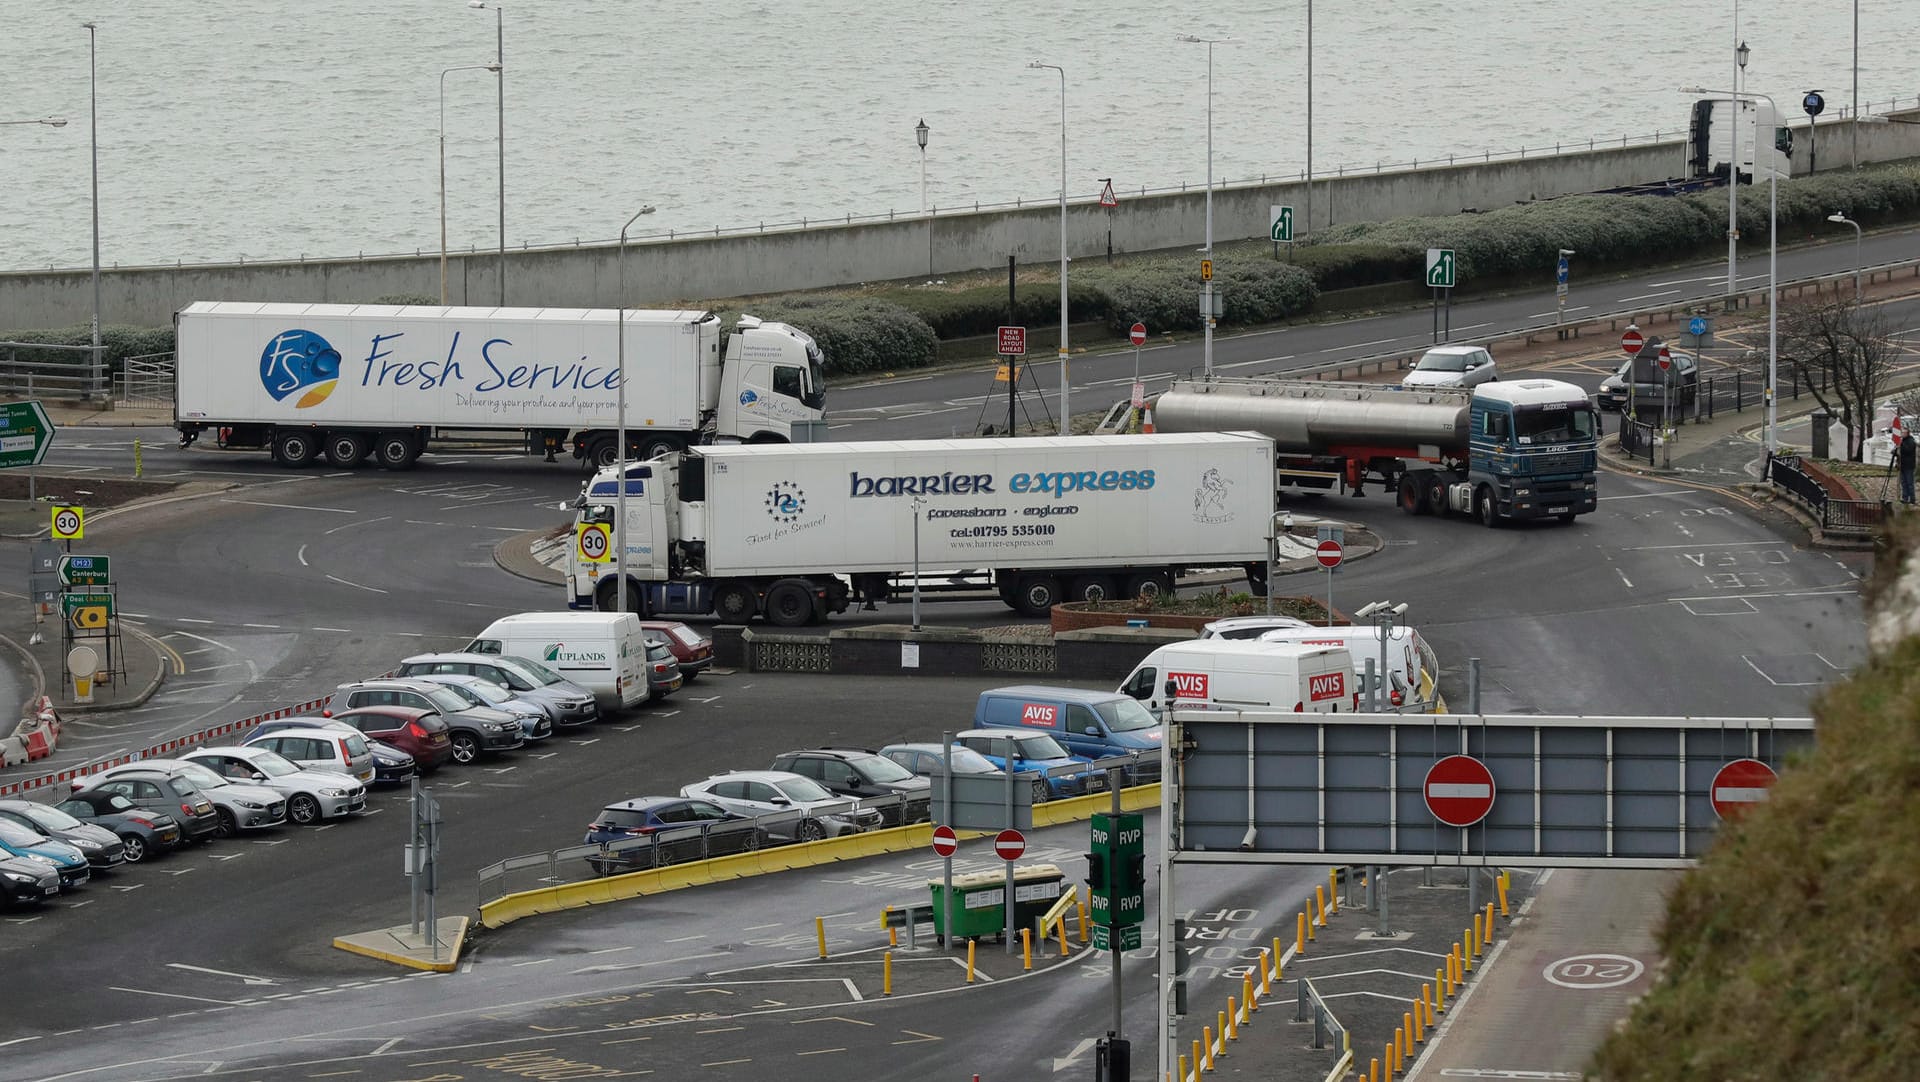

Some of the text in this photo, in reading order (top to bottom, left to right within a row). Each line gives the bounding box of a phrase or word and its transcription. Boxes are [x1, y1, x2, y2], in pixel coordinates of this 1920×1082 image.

[361, 331, 630, 392] Fresh Service
[456, 392, 630, 414] Delivering your produce and your prome
[757, 396, 777, 409] Fresh
[850, 469, 1156, 499] harrier express
[59, 517, 77, 528] 30
[1012, 524, 1055, 536] 535010
[584, 535, 604, 550] 30
[745, 532, 771, 545] First
[950, 537, 1055, 550] www.harrier-express.com
[72, 570, 107, 578] Canterbury
[559, 652, 606, 661] UPLANDS
[1173, 675, 1204, 692] AVIS
[1312, 676, 1340, 695] AVIS
[1024, 706, 1053, 721] AVIS
[1092, 829, 1108, 844] RVP
[1119, 829, 1140, 845] RVP
[1092, 895, 1109, 911] RVP
[1120, 895, 1141, 911] RVP
[1561, 963, 1629, 978] 20
